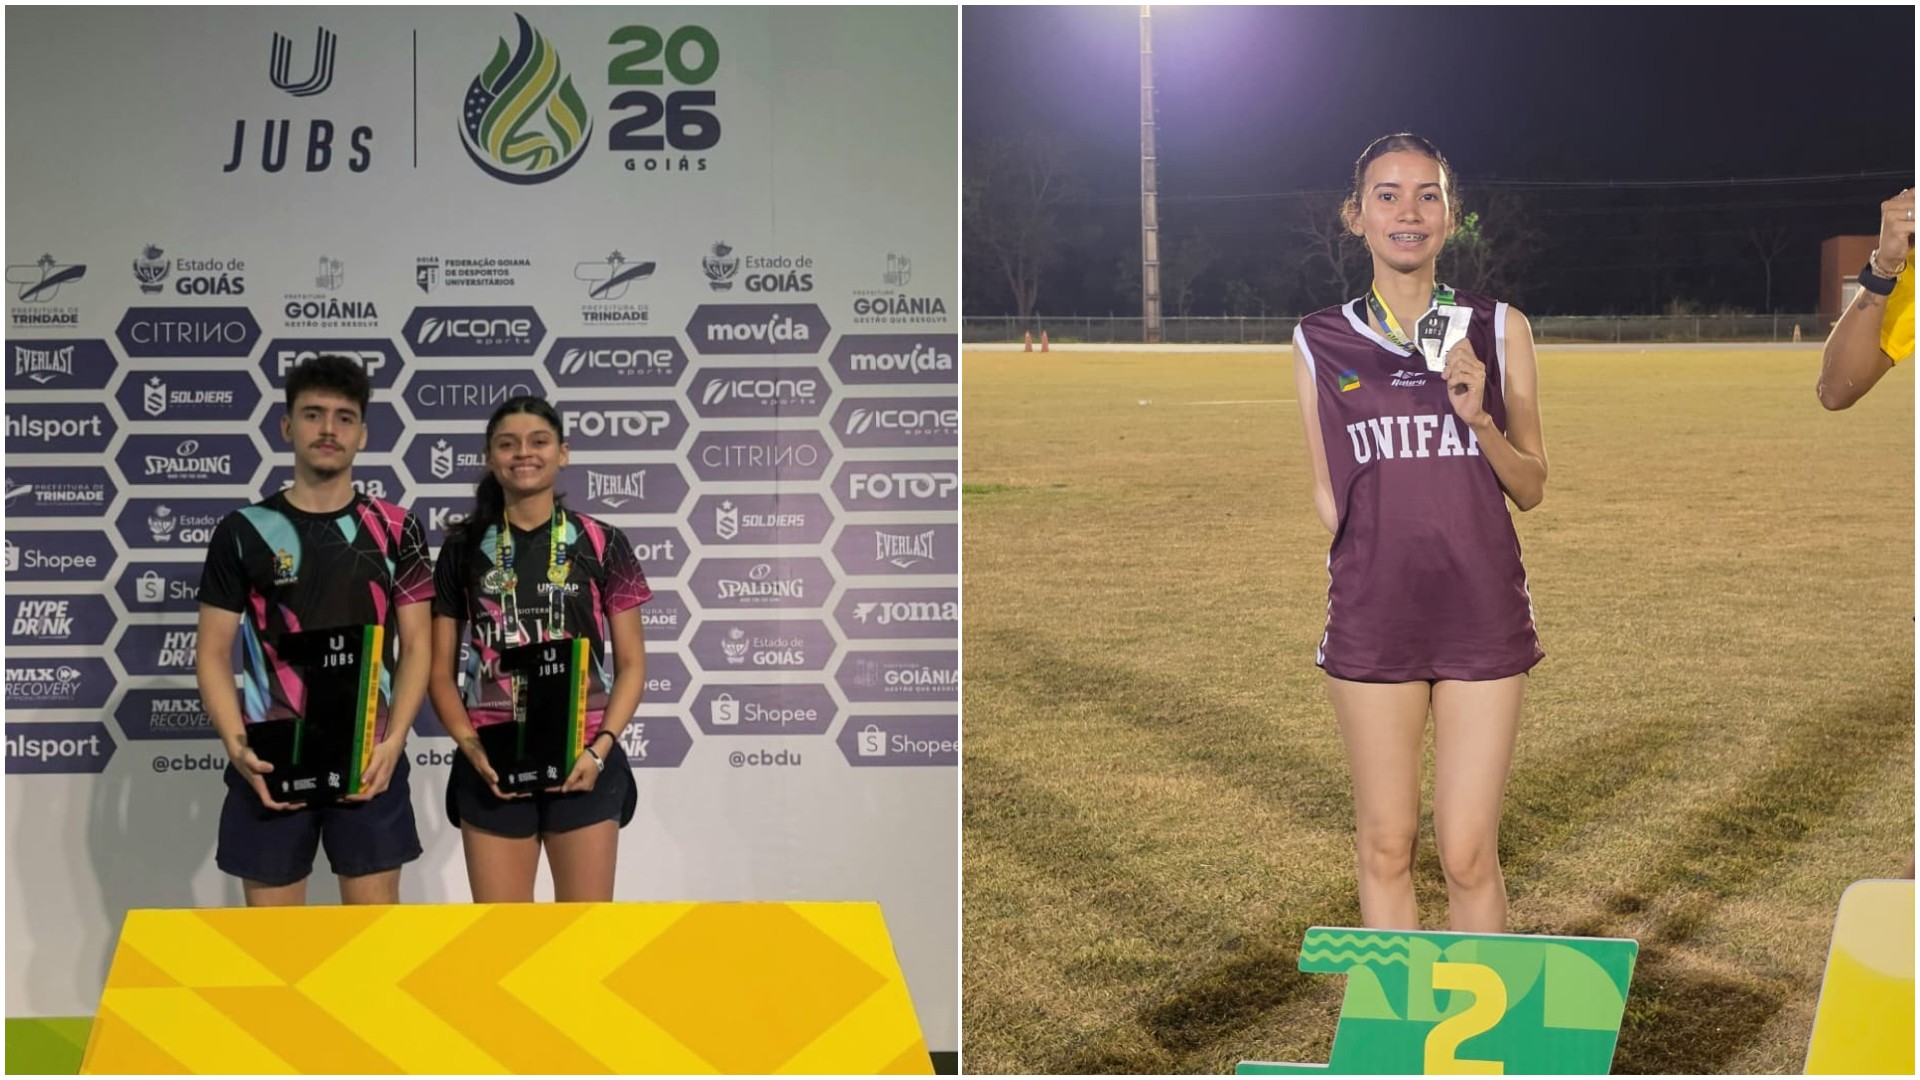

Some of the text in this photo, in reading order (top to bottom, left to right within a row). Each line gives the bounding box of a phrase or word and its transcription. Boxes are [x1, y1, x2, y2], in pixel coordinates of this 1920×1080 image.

[608, 26, 720, 85] 20
[608, 90, 722, 151] 26
[624, 154, 708, 171] GOIÁS
[176, 259, 245, 272] Estado de
[445, 258, 531, 268] FEDERAÇÃO GOIANA
[745, 255, 813, 269] Estado de
[445, 269, 456, 277] DE
[458, 269, 510, 277] DESPORTOS
[445, 278, 515, 286] UNIVERSITÁRIOS
[745, 271, 813, 292] GOIÁS
[175, 273, 245, 296] GOIÁS
[285, 298, 378, 319] GOIÂNIA
[854, 294, 946, 315] GOIÂNIA
[12, 314, 79, 324] TRINDADE
[582, 312, 649, 321] TRINDADE
[708, 313, 809, 344] movida
[15, 345, 74, 376] EVERLAST
[850, 344, 952, 375] movida
[170, 391, 233, 403] SOLDIERS
[563, 411, 670, 437] FOTOP
[145, 454, 231, 475] SPALDING
[587, 470, 646, 500] EVERLAST
[850, 473, 958, 498] FOTOP
[35, 491, 104, 501] TRINDADE
[180, 515, 215, 525] Estado
[741, 514, 805, 527] SOLDIERS
[876, 530, 934, 560] EVERLAST
[24, 550, 97, 574] Shopee
[718, 578, 803, 599] SPALDING
[19, 601, 69, 618] HYPE
[753, 637, 803, 648] Estado de
[753, 649, 804, 666] GOIÁS
[5, 669, 54, 681] MAX
[5, 682, 81, 696] RECOVERY
[152, 700, 200, 712] MAX
[745, 703, 817, 726] Shopee
[152, 754, 225, 772] @cbdu
[729, 750, 802, 768] @cbdu
[1424, 962, 1508, 1075] 2
